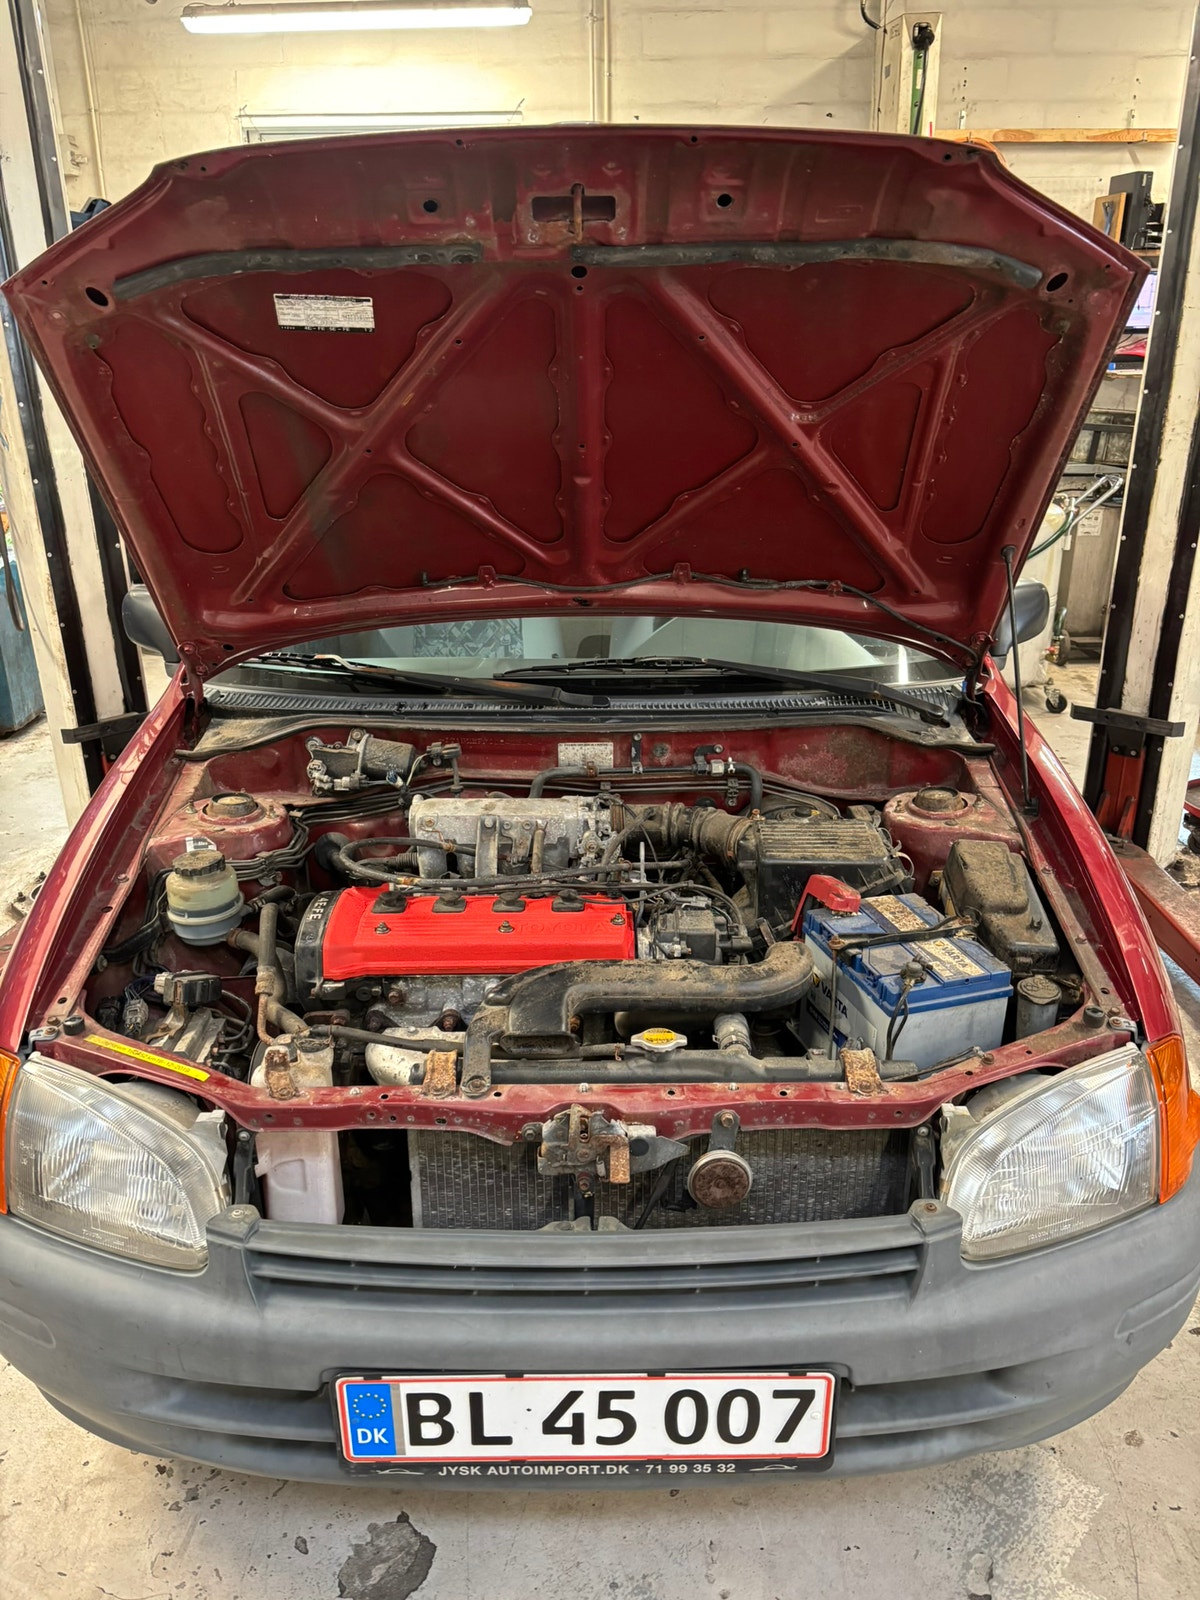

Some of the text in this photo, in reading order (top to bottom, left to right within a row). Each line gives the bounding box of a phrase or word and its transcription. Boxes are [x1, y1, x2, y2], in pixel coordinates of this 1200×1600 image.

[519, 921, 607, 933] TOYOTA
[942, 945, 969, 968] VARTA
[406, 1388, 816, 1446] BL 45 007
[356, 1427, 389, 1444] DK
[438, 1463, 736, 1476] JYSK AUTOIMPORT.DK 71 99 35 32
